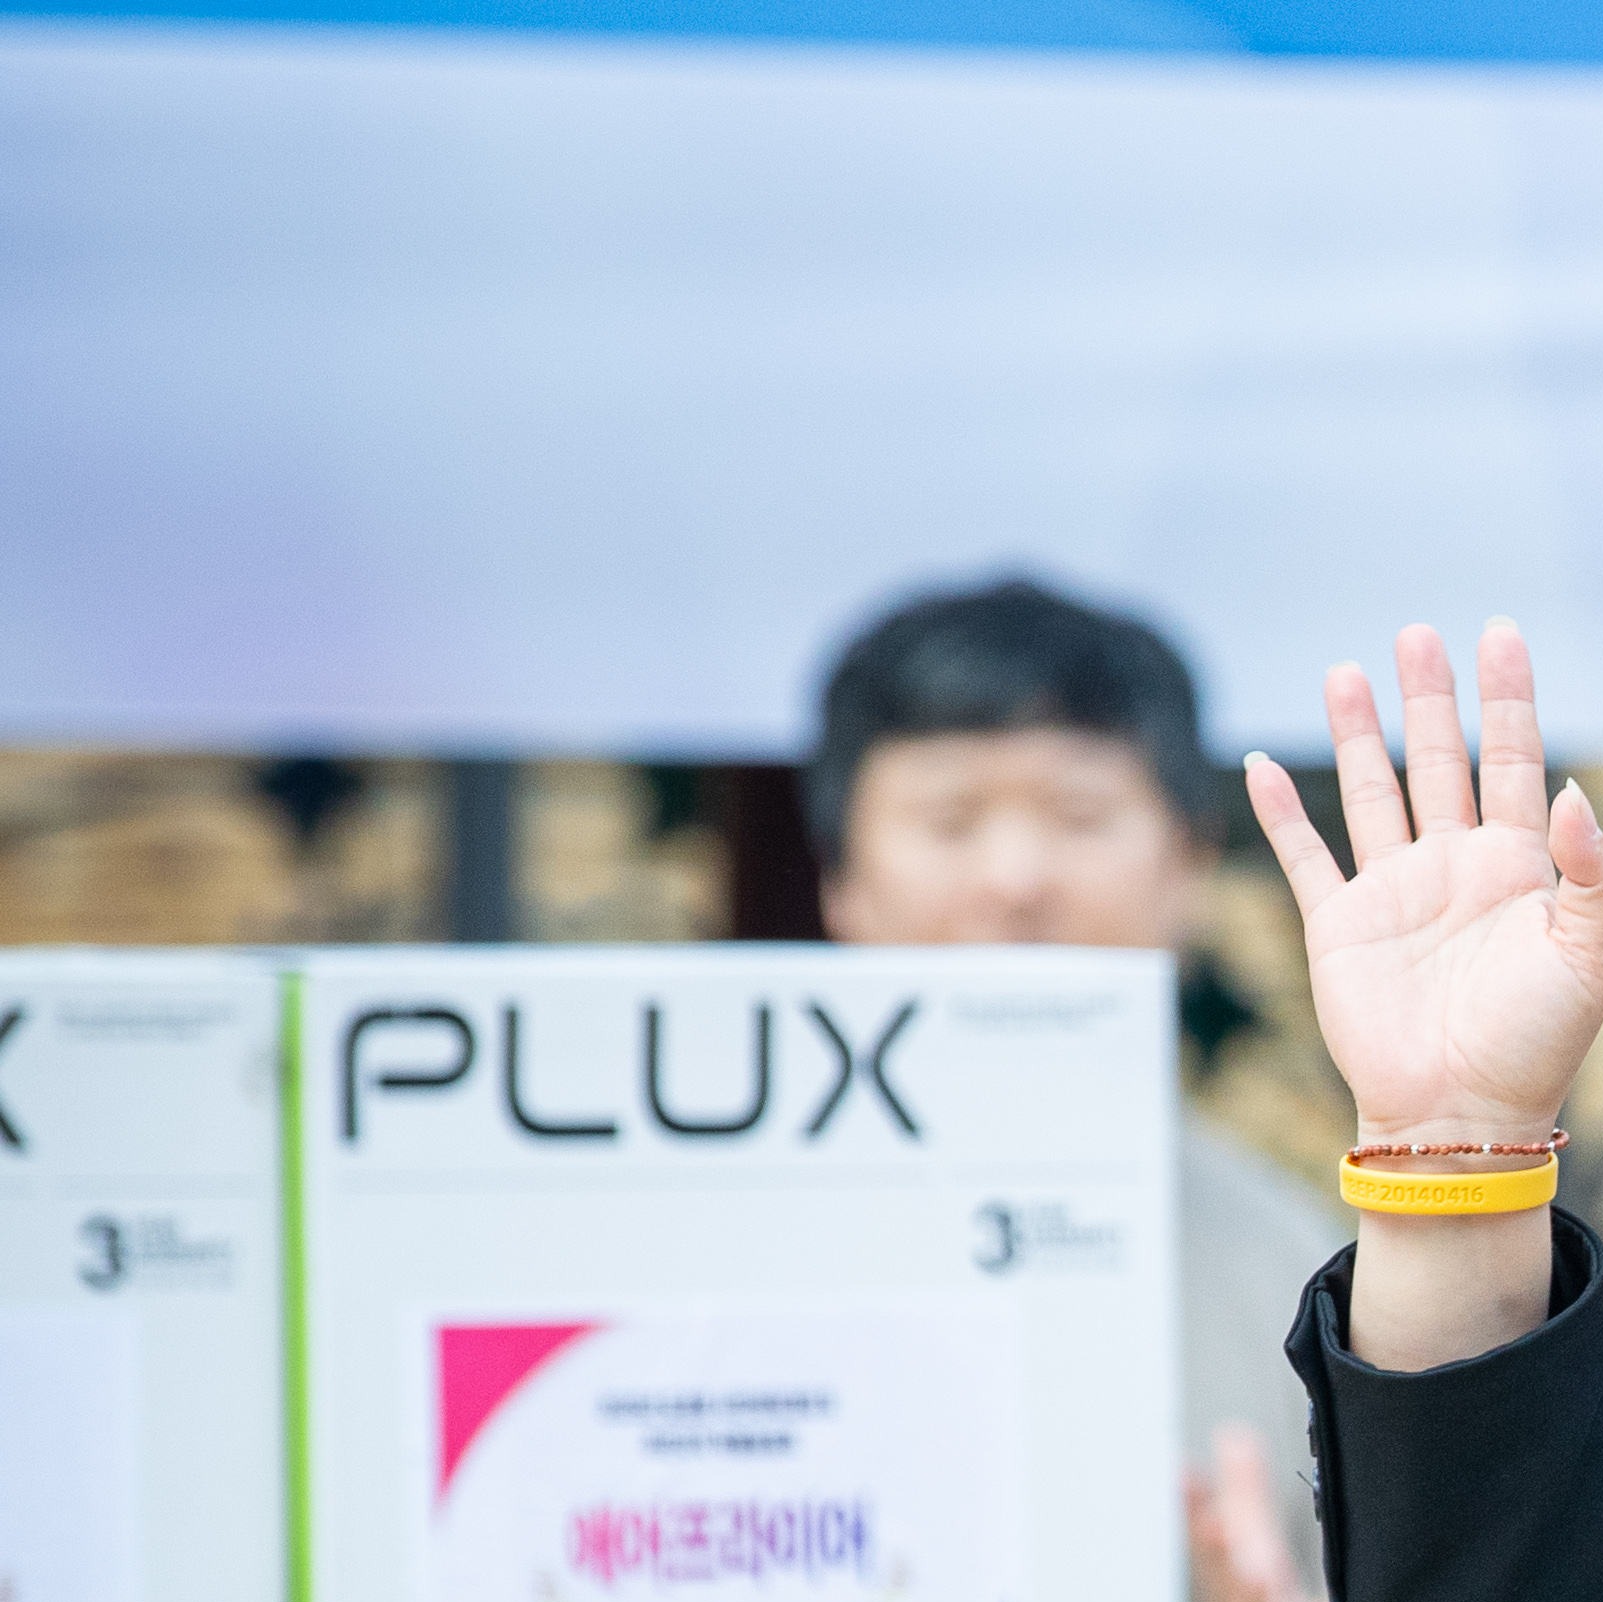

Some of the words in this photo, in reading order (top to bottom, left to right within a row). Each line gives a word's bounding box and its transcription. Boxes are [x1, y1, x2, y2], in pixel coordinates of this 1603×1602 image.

[338, 1000, 920, 1143] PLUX
[1380, 1184, 1483, 1204] 20140416
[567, 1495, 875, 1585] 에어프라이어
